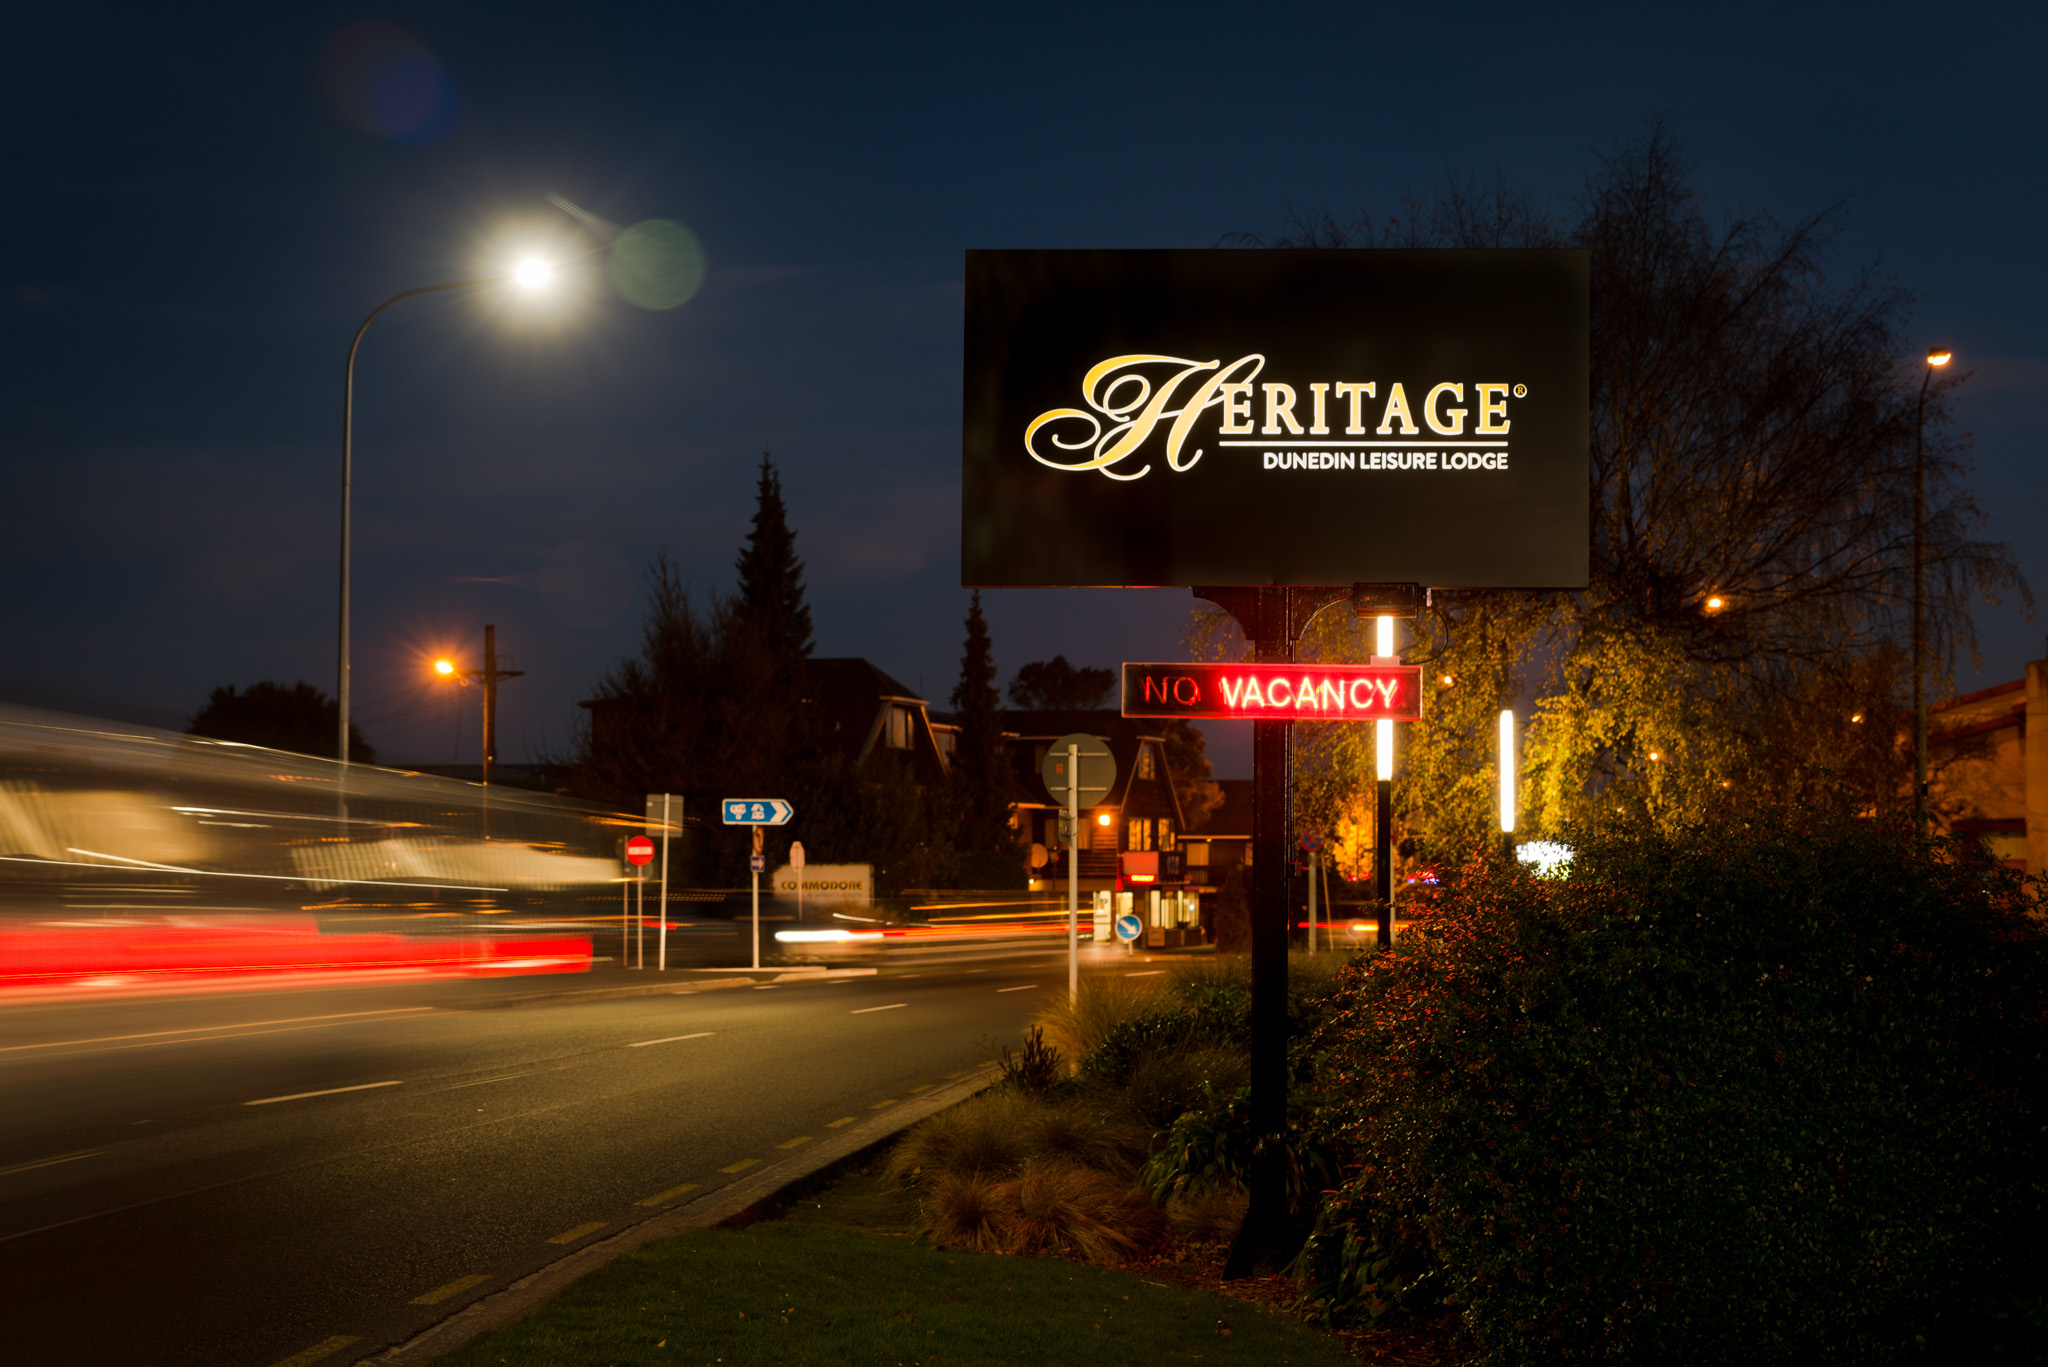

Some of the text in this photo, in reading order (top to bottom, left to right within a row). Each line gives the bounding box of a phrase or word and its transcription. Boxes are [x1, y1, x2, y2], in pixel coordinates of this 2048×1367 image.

[1263, 451, 1509, 470] DUNEDIN LEISURE LODGE
[1143, 676, 1398, 710] NO VACANCY
